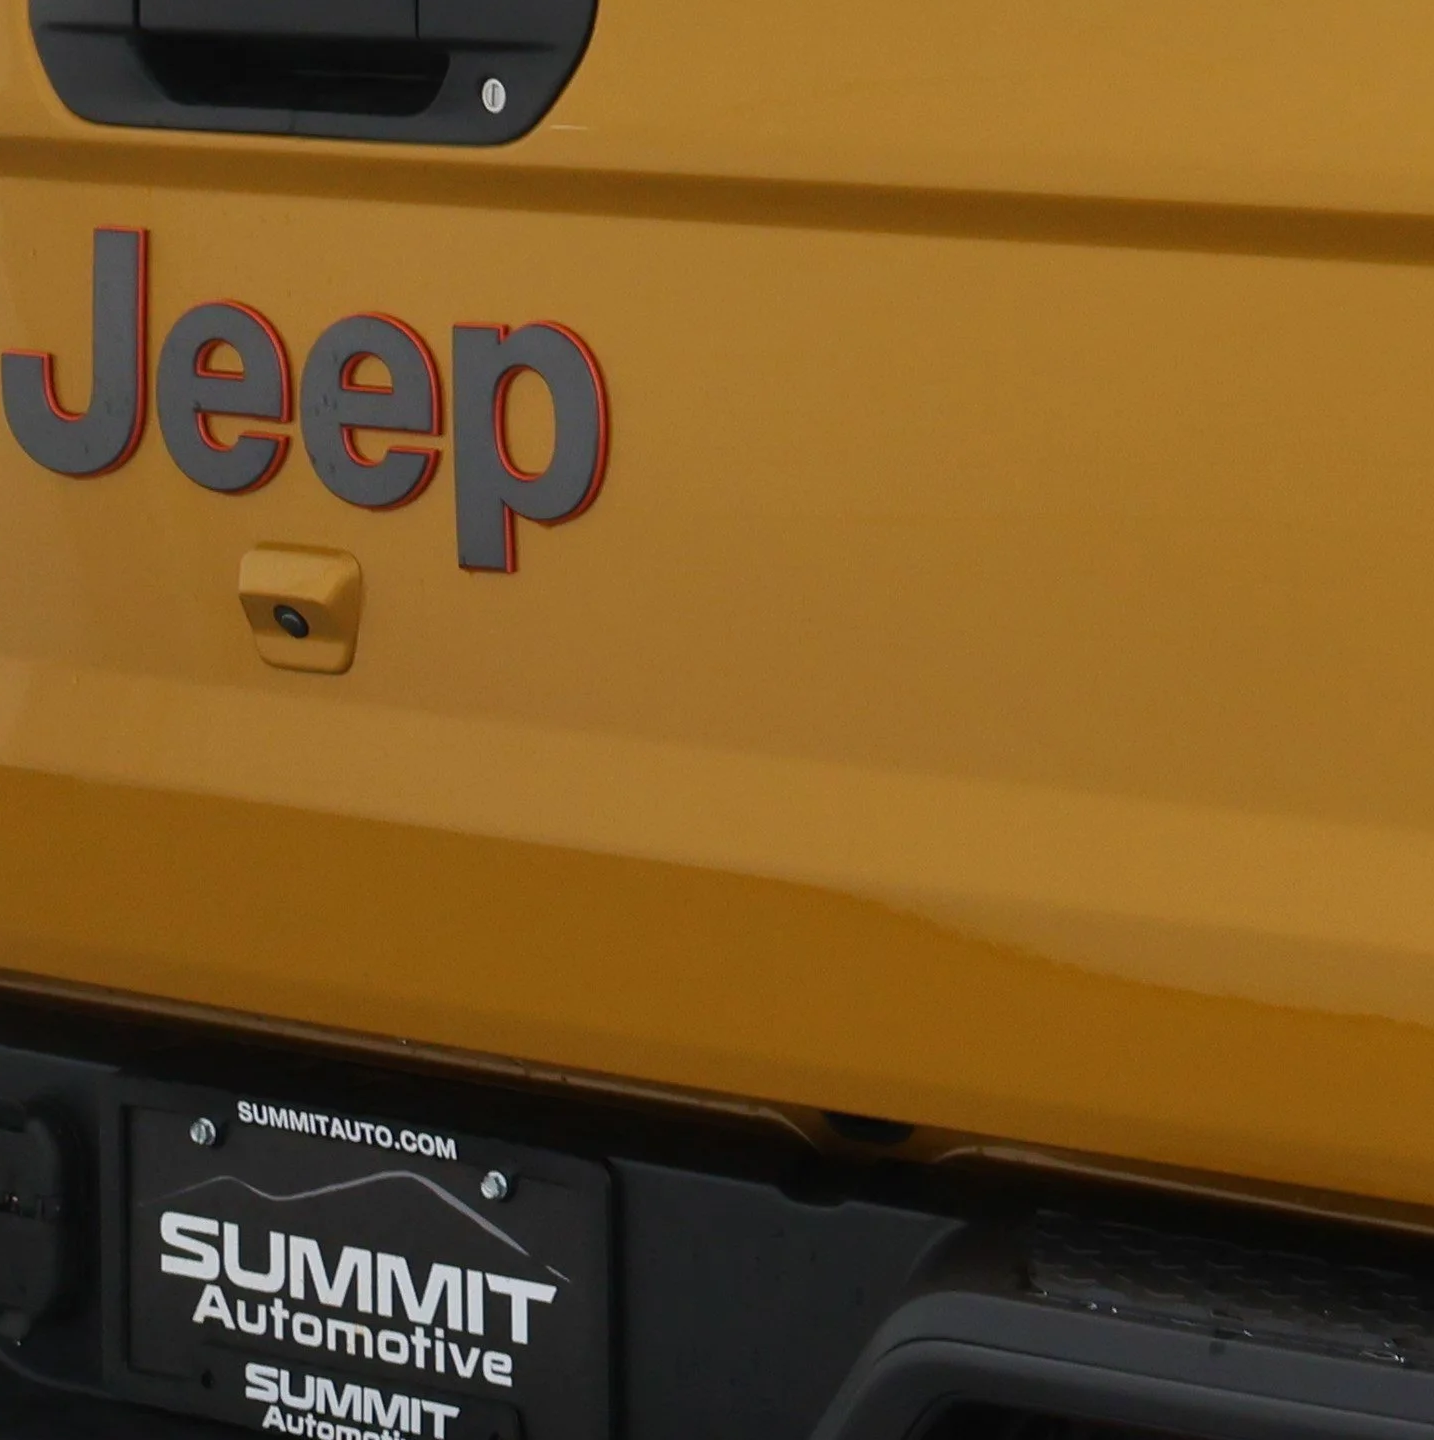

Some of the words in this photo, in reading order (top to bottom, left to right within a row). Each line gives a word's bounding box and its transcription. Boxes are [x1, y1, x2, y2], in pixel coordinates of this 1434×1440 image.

[1, 225, 609, 573] Jeep
[237, 1100, 458, 1160] SUMMITAUTO.COM
[160, 1211, 558, 1346] SUMMIT
[192, 1284, 514, 1388] Automotive
[245, 1362, 461, 1440] SUMMIT
